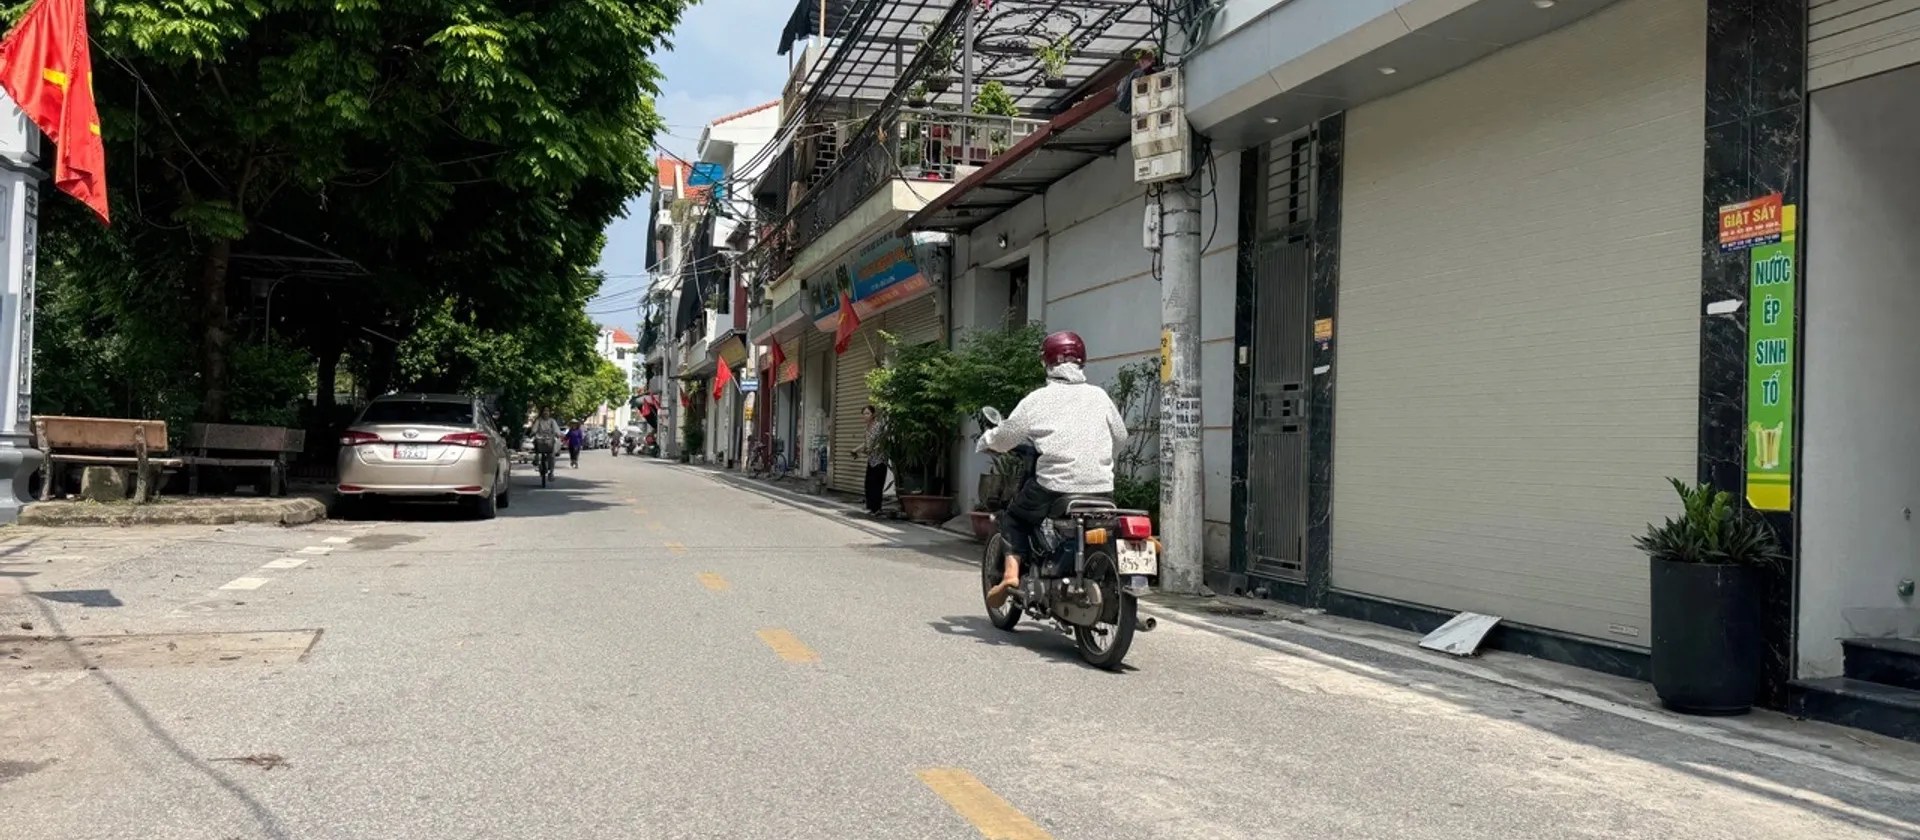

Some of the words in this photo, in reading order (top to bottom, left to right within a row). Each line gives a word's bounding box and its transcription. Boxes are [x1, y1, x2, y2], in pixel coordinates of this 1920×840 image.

[1754, 252, 1791, 286] NƯỚC
[1763, 295, 1781, 325] ÉP
[1755, 339, 1787, 365] SINH
[1762, 370, 1780, 405] TỐ
